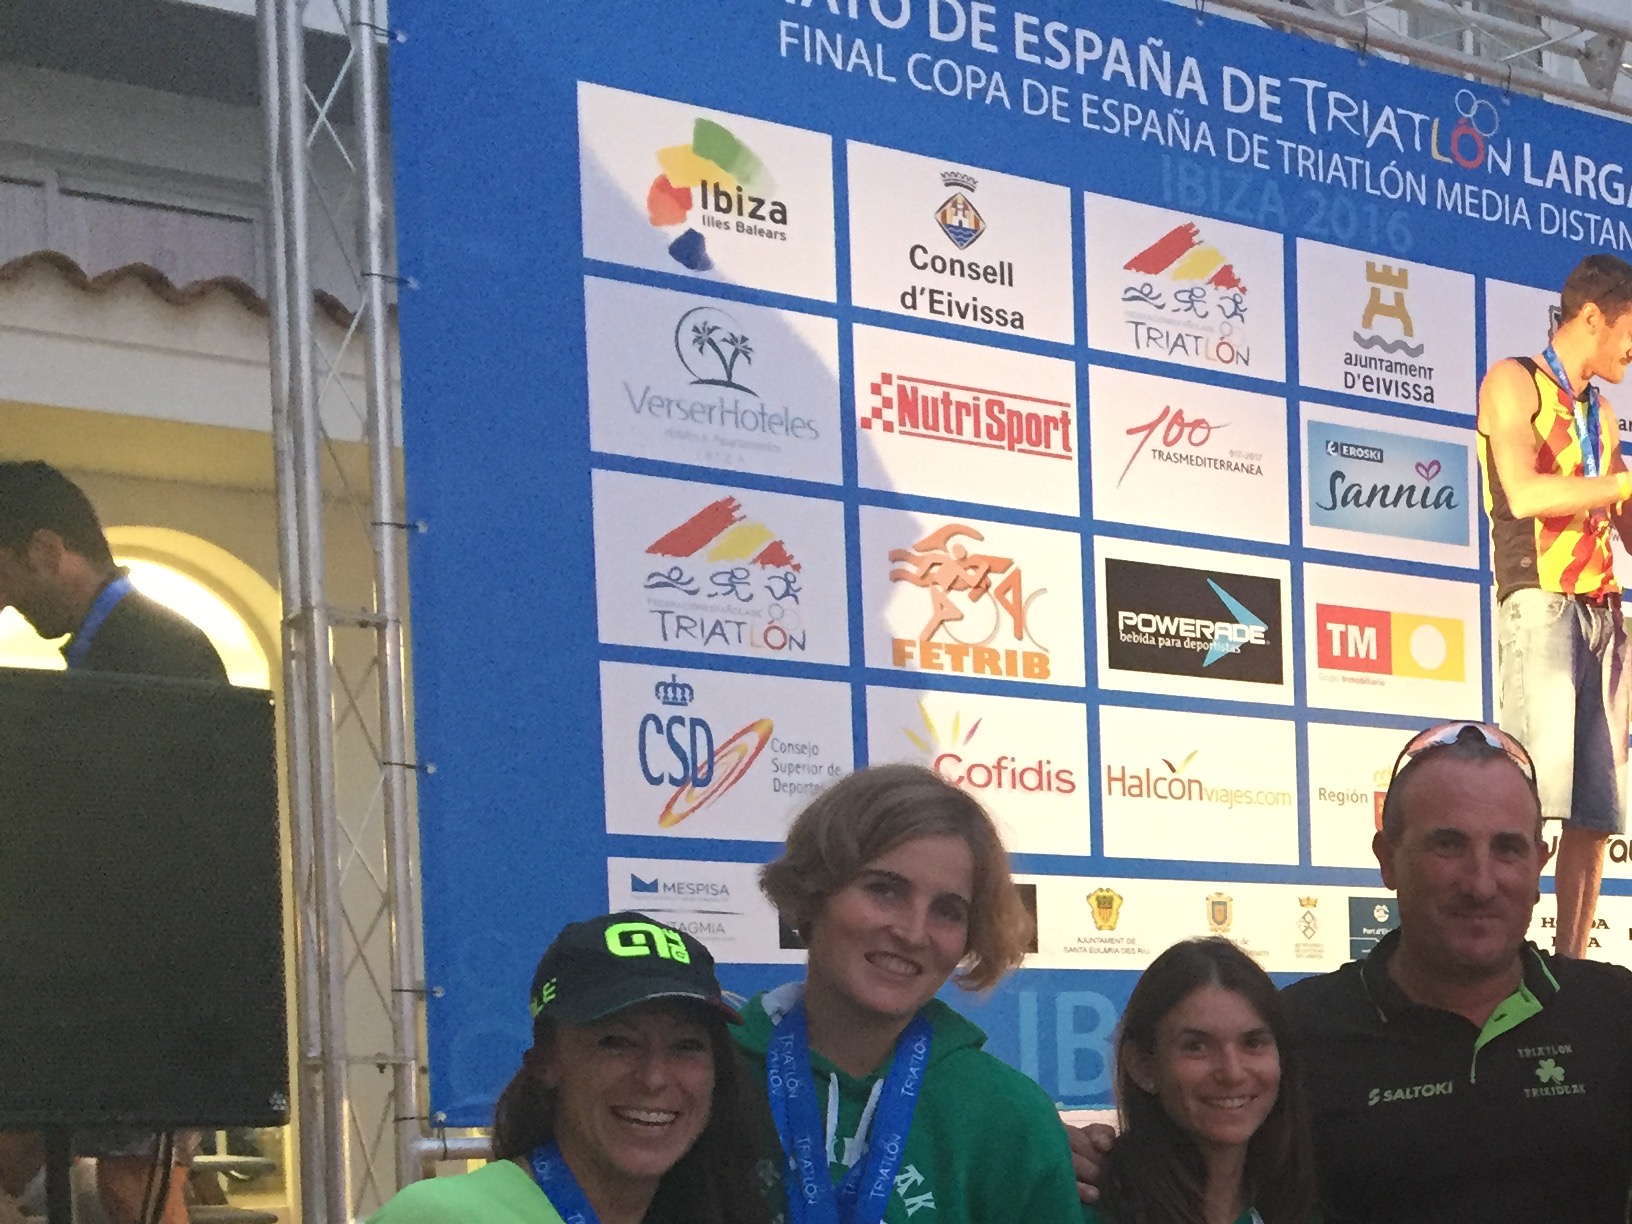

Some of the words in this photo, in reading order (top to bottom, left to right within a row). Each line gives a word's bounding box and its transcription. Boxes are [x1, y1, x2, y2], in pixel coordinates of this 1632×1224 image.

[929, 0, 998, 53] DE
[1014, 11, 1208, 105] ESPAÑA
[1222, 65, 1283, 124] DE
[1289, 77, 1511, 177] TRIATLÓN
[779, 19, 897, 83] FINAL
[907, 52, 1010, 110] COPA
[1022, 78, 1071, 123] DE
[1082, 92, 1216, 157] ESPAÑA
[1226, 127, 1271, 170] DE
[1276, 139, 1426, 206] TRIATLÓN
[1437, 177, 1532, 231] MEDIA
[701, 179, 788, 226] Ibiza
[1161, 153, 1287, 230] IBIZA
[1303, 189, 1413, 252] 2016
[736, 221, 788, 242] Balears
[909, 244, 1014, 288] Consell
[900, 285, 1025, 331] d'Eivissa
[622, 381, 820, 440] VerserHoteles
[896, 383, 1073, 453] NutriSport
[1151, 449, 1264, 477] TRASMEDITERRANEA
[1342, 444, 1382, 461] EROSKI
[1315, 470, 1460, 512] Sannia
[649, 610, 806, 652] TRIATLÓN
[1118, 610, 1266, 645] POWERADE
[1119, 630, 1156, 646] bebida
[1158, 636, 1182, 649] para
[1184, 637, 1241, 654] deportistas
[1326, 622, 1378, 661] TM
[892, 637, 1051, 680] FETRIB
[638, 713, 715, 788] CSD
[770, 737, 819, 758] Consejo
[771, 758, 823, 776] Superior
[827, 762, 842, 776] de
[934, 753, 1076, 794] Cofidis
[1318, 786, 1369, 806] Región
[663, 882, 730, 896] MESPISA
[666, 920, 726, 935] TAGMIA
[1383, 1081, 1454, 1102] SALTOKI
